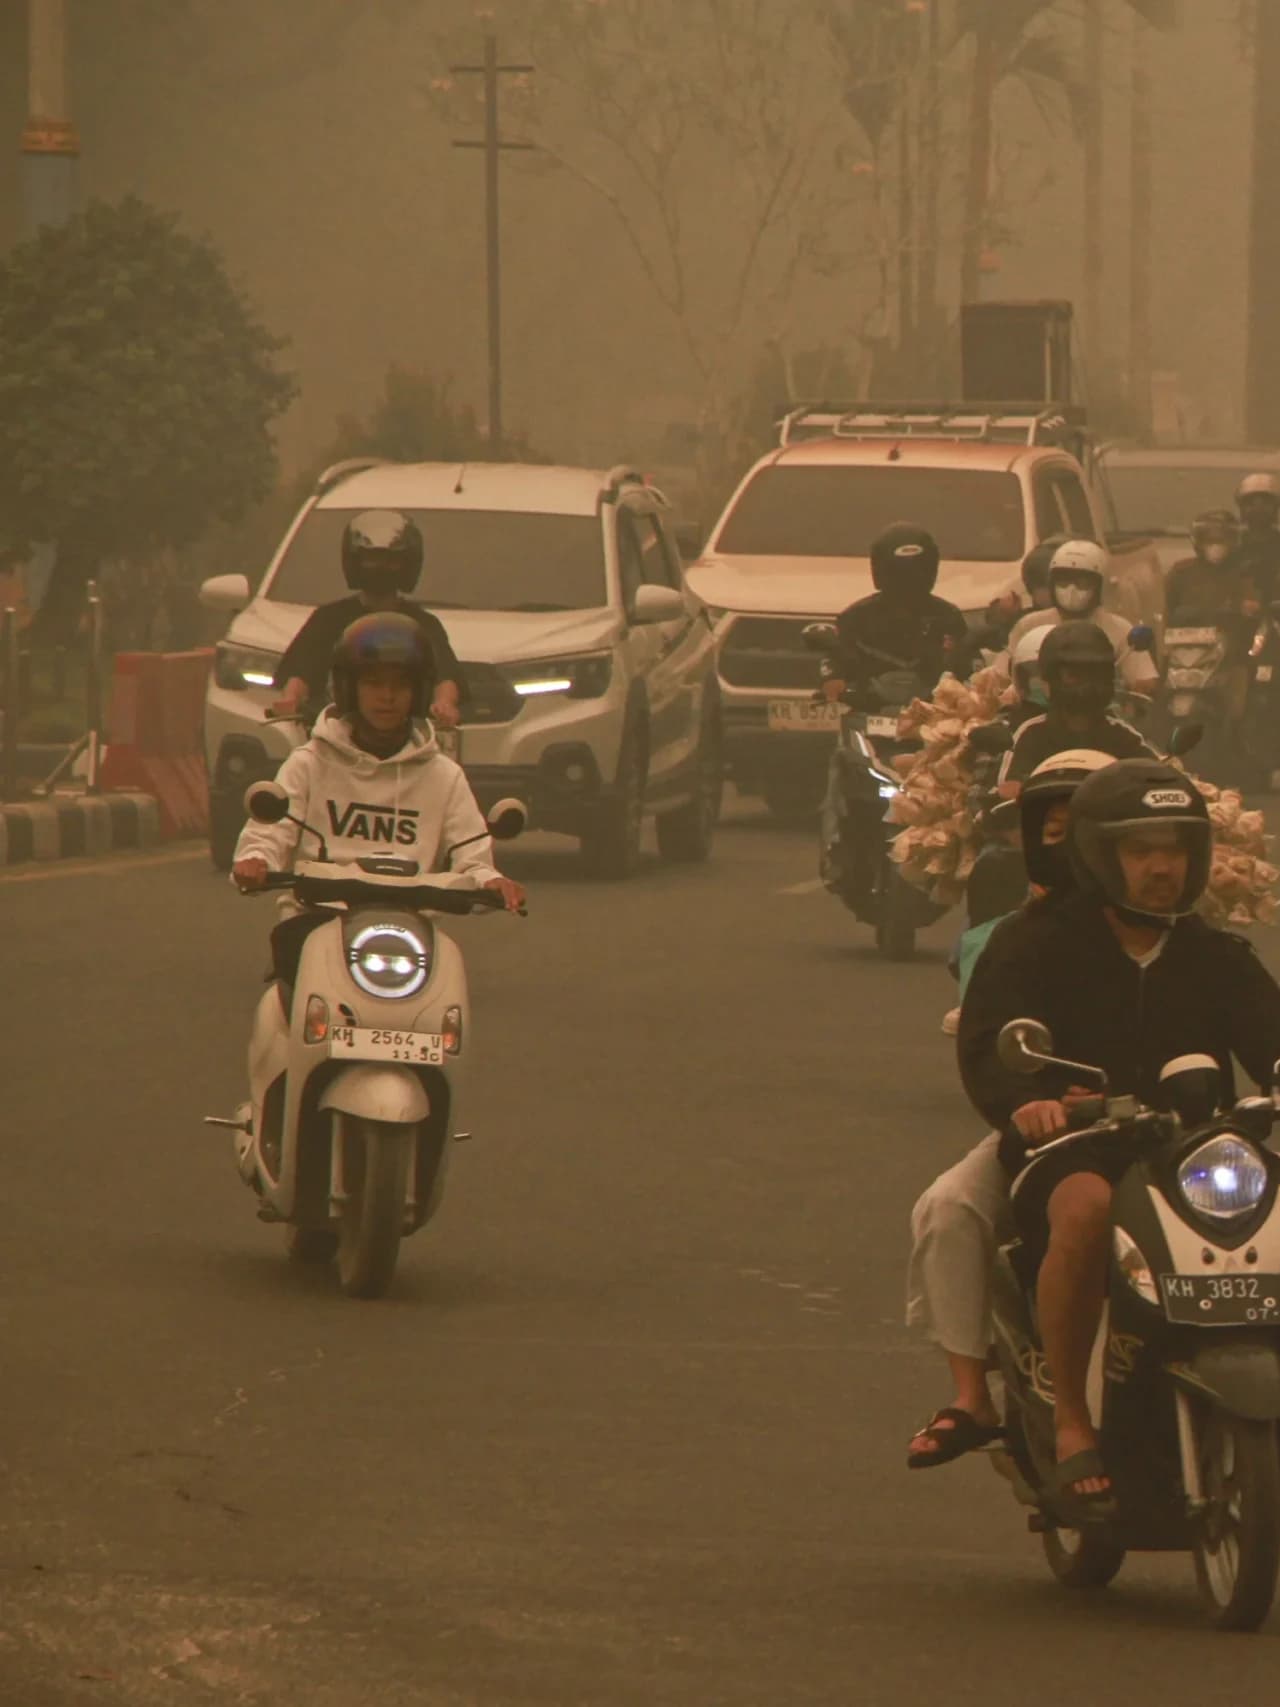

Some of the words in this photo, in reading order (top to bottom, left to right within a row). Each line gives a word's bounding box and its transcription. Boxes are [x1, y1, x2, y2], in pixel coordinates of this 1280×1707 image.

[1151, 793, 1185, 804] SHOEI
[326, 799, 419, 845] VANS
[332, 1028, 353, 1042] KH
[371, 1030, 415, 1046] 2564
[431, 1035, 441, 1048] U
[1165, 1278, 1194, 1297] KH
[1207, 1278, 1260, 1299] 3832
